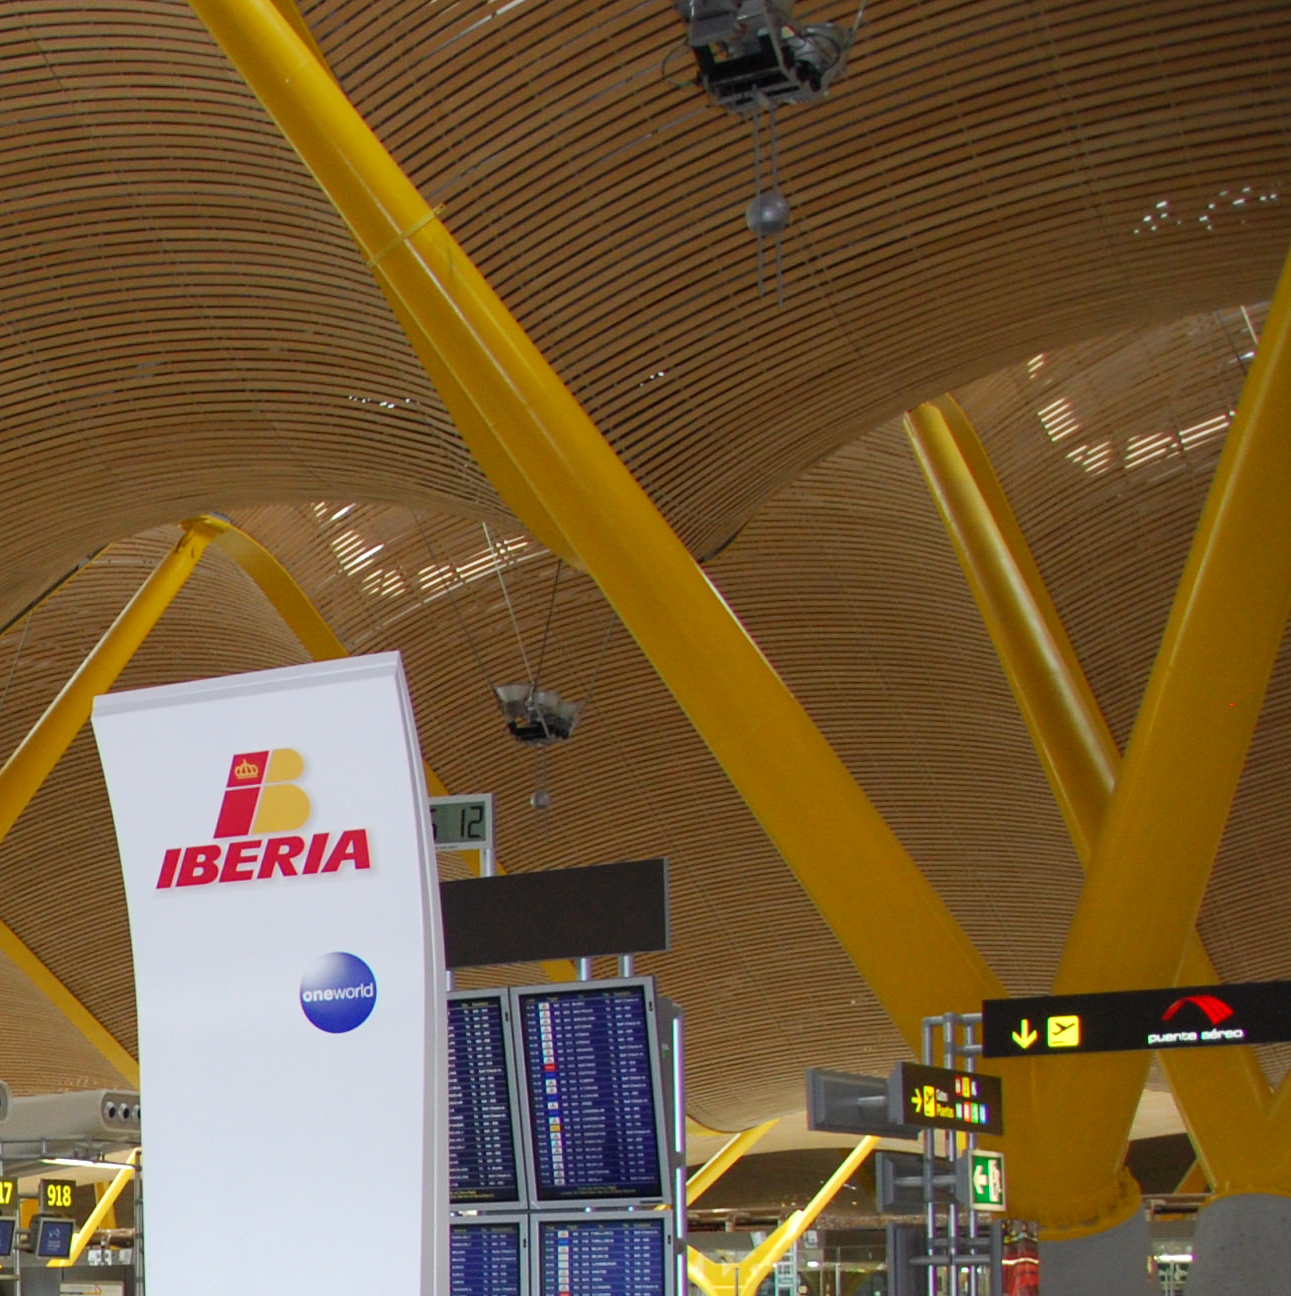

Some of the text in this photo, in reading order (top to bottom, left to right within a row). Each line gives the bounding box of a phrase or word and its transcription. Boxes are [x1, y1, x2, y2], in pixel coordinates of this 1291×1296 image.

[460, 805, 484, 839] 12
[155, 828, 371, 889] IBERIA
[302, 982, 374, 1003] oneworld
[1147, 1027, 1245, 1045] puente aéreo
[47, 1184, 72, 1207] 918
